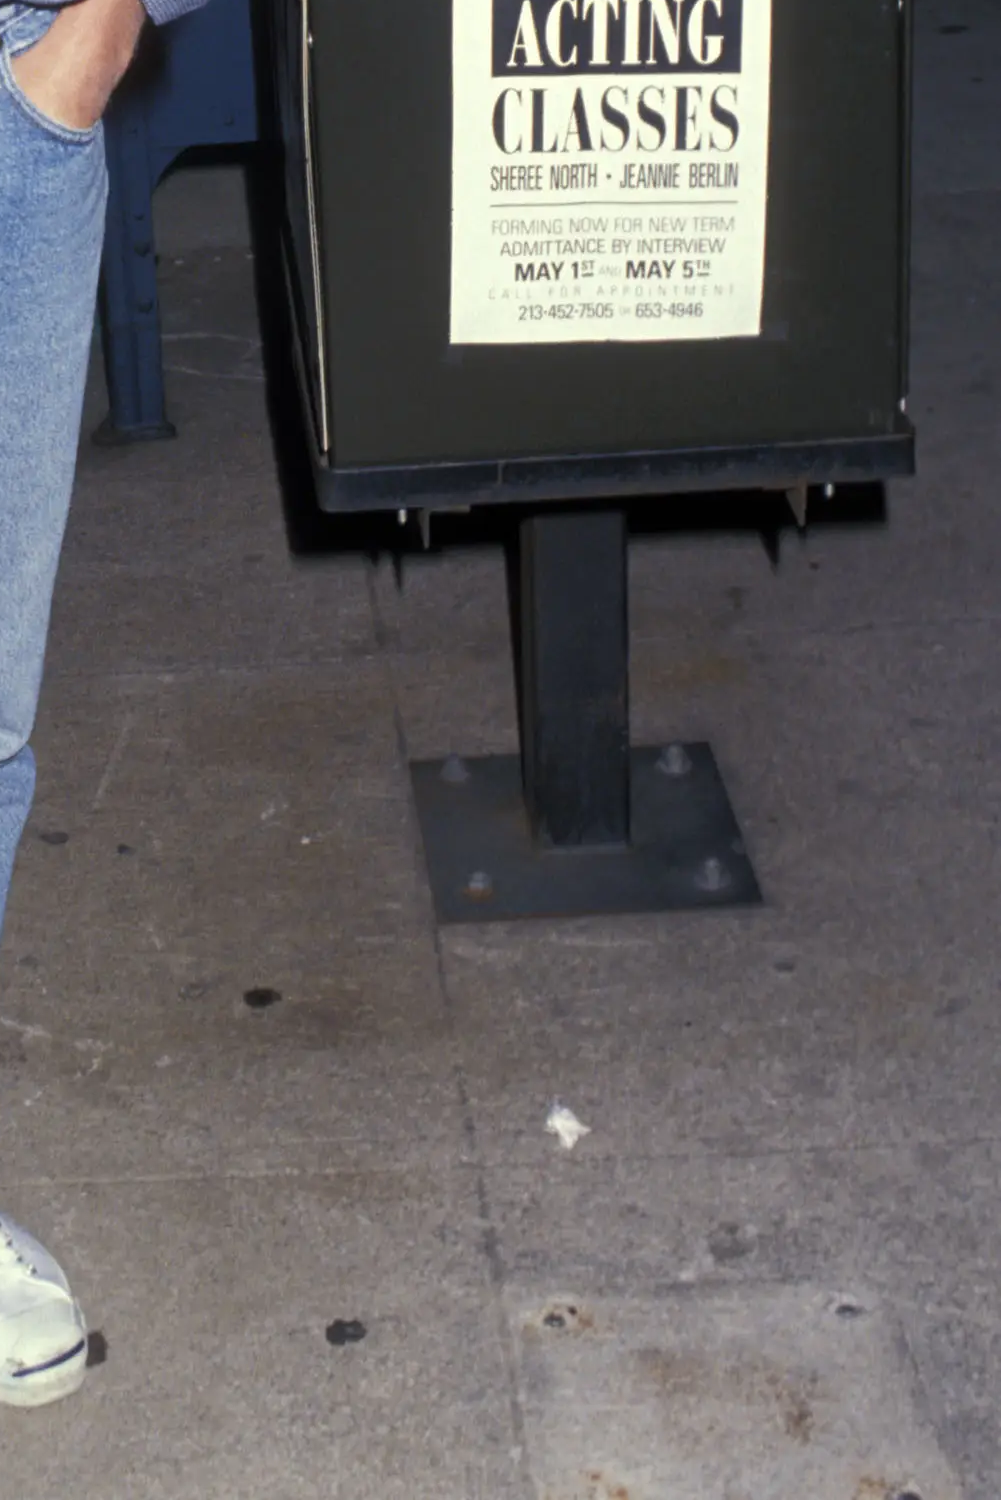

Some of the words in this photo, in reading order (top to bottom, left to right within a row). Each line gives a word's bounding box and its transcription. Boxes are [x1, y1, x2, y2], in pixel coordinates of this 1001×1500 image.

[491, 84, 740, 155] CLASSES
[490, 165, 543, 191] SHEREE
[549, 164, 598, 190] NORTH
[620, 163, 680, 188] JEANNIE
[688, 162, 738, 188] BERLIN
[491, 219, 563, 236] FORMING
[569, 218, 609, 234] NOW
[614, 217, 643, 233] FOR
[649, 217, 687, 233] NEW
[693, 216, 736, 232] TERM
[500, 238, 606, 257] ADMITTANCE
[611, 238, 632, 254] BY
[637, 238, 727, 254] INTERVIEW
[514, 262, 564, 282] MAY
[625, 260, 676, 280] MAY
